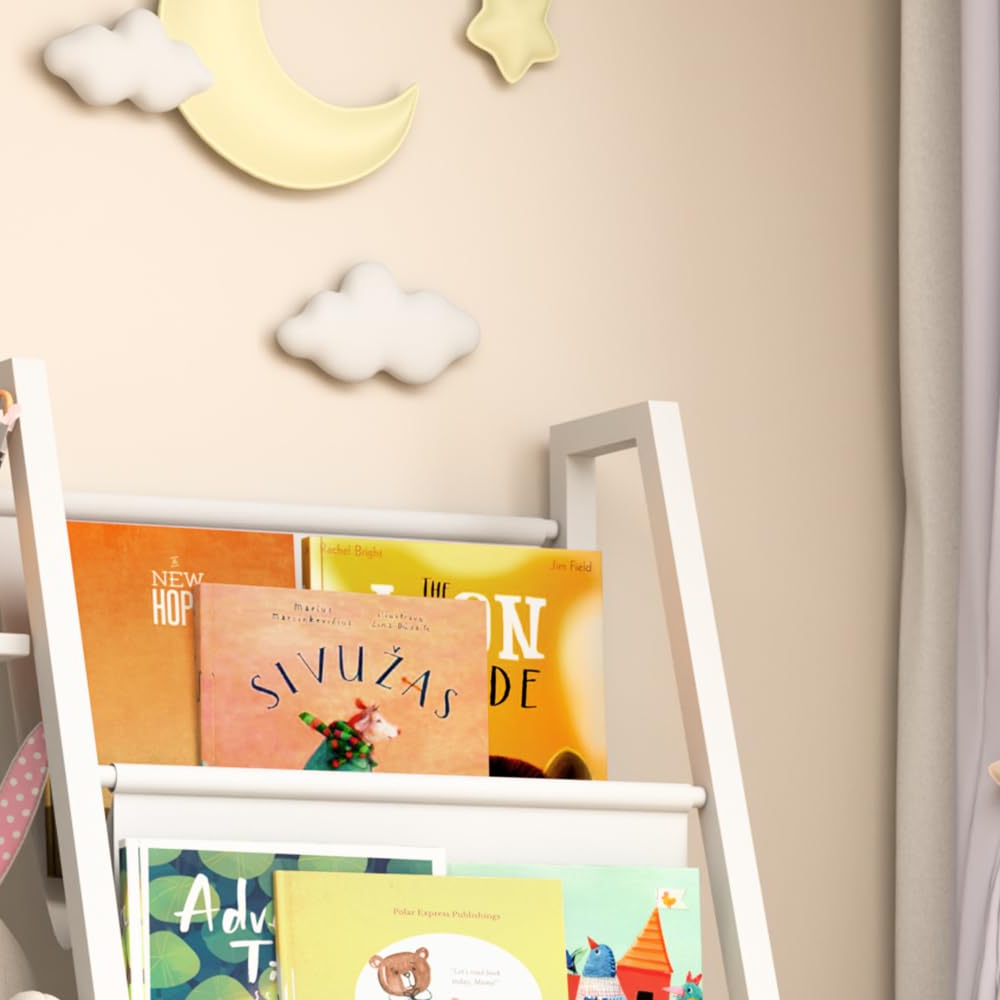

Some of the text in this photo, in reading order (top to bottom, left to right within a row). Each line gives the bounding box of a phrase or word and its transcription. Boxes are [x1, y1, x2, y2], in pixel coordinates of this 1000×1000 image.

[354, 545, 384, 559] Bright
[570, 559, 592, 572] Field
[151, 569, 204, 588] NEW
[151, 588, 194, 627] HOP
[251, 645, 458, 719] SIVUŽAS
[173, 872, 276, 934] Adv
[392, 906, 416, 917] Polar
[417, 908, 450, 919] Express
